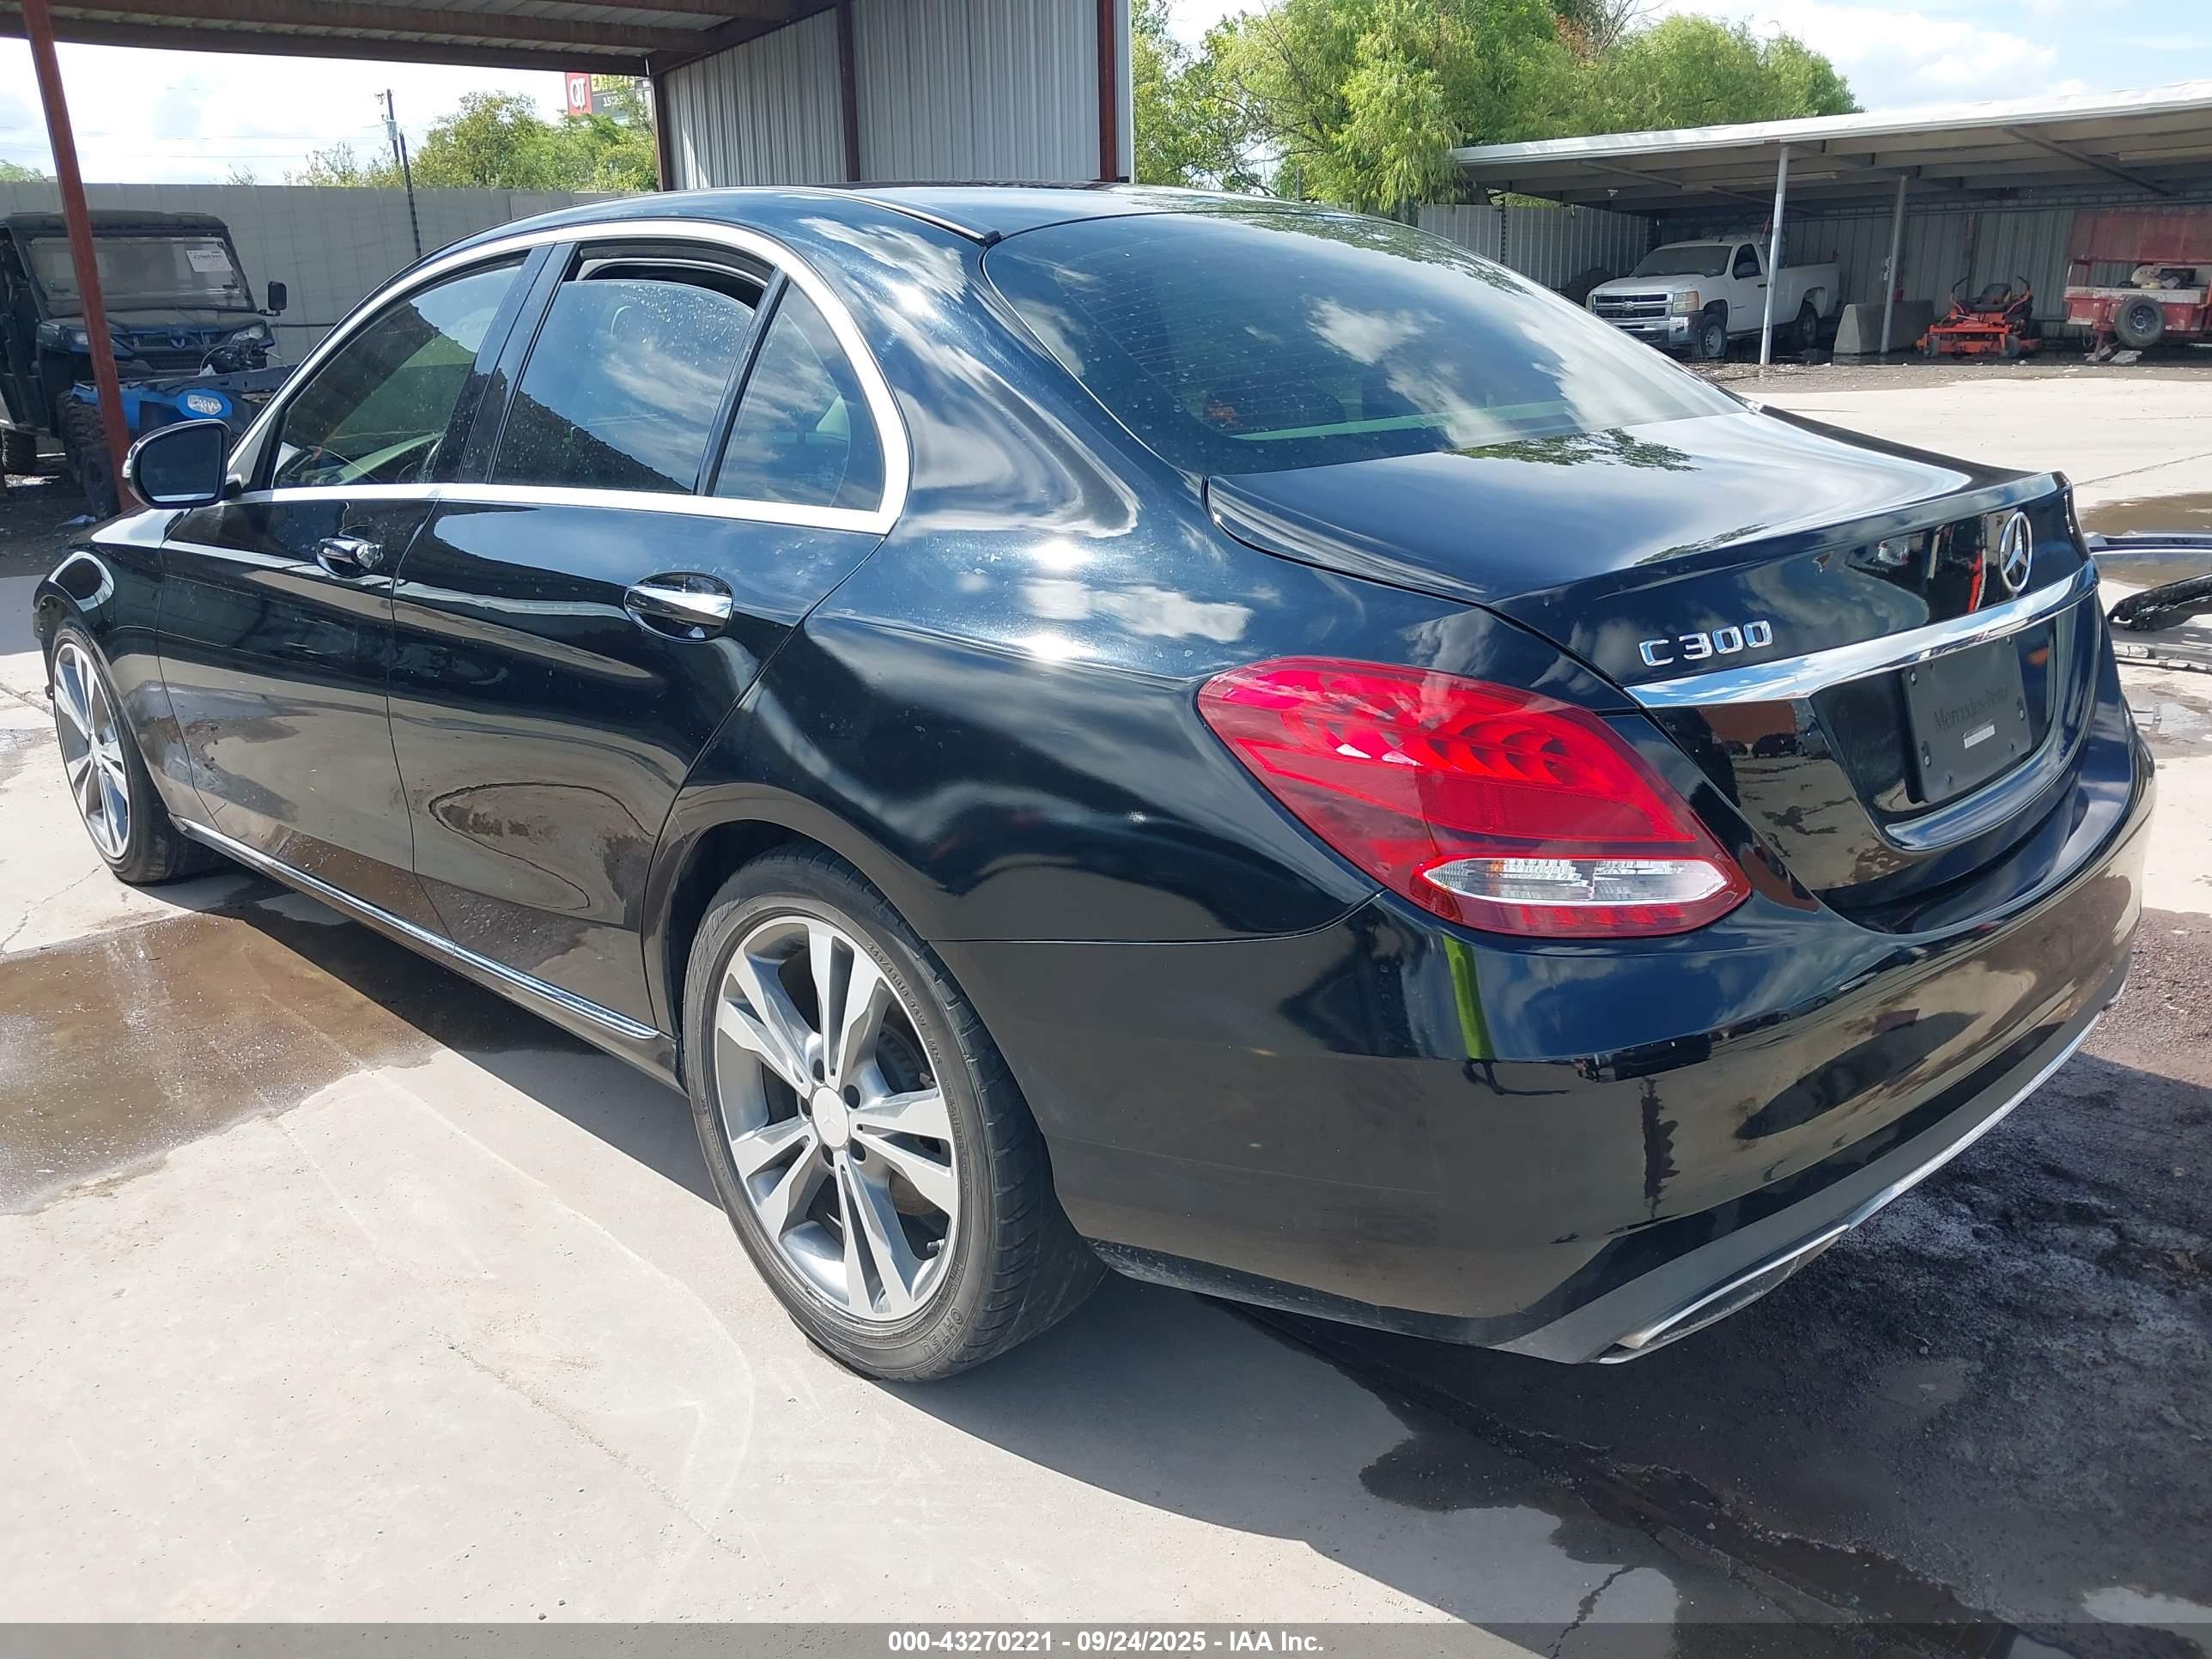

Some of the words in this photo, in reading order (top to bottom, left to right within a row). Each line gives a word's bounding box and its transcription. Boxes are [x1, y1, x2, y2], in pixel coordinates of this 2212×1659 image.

[568, 77, 586, 111] QT
[1638, 639, 1674, 666] C
[1678, 619, 1773, 660] 300
